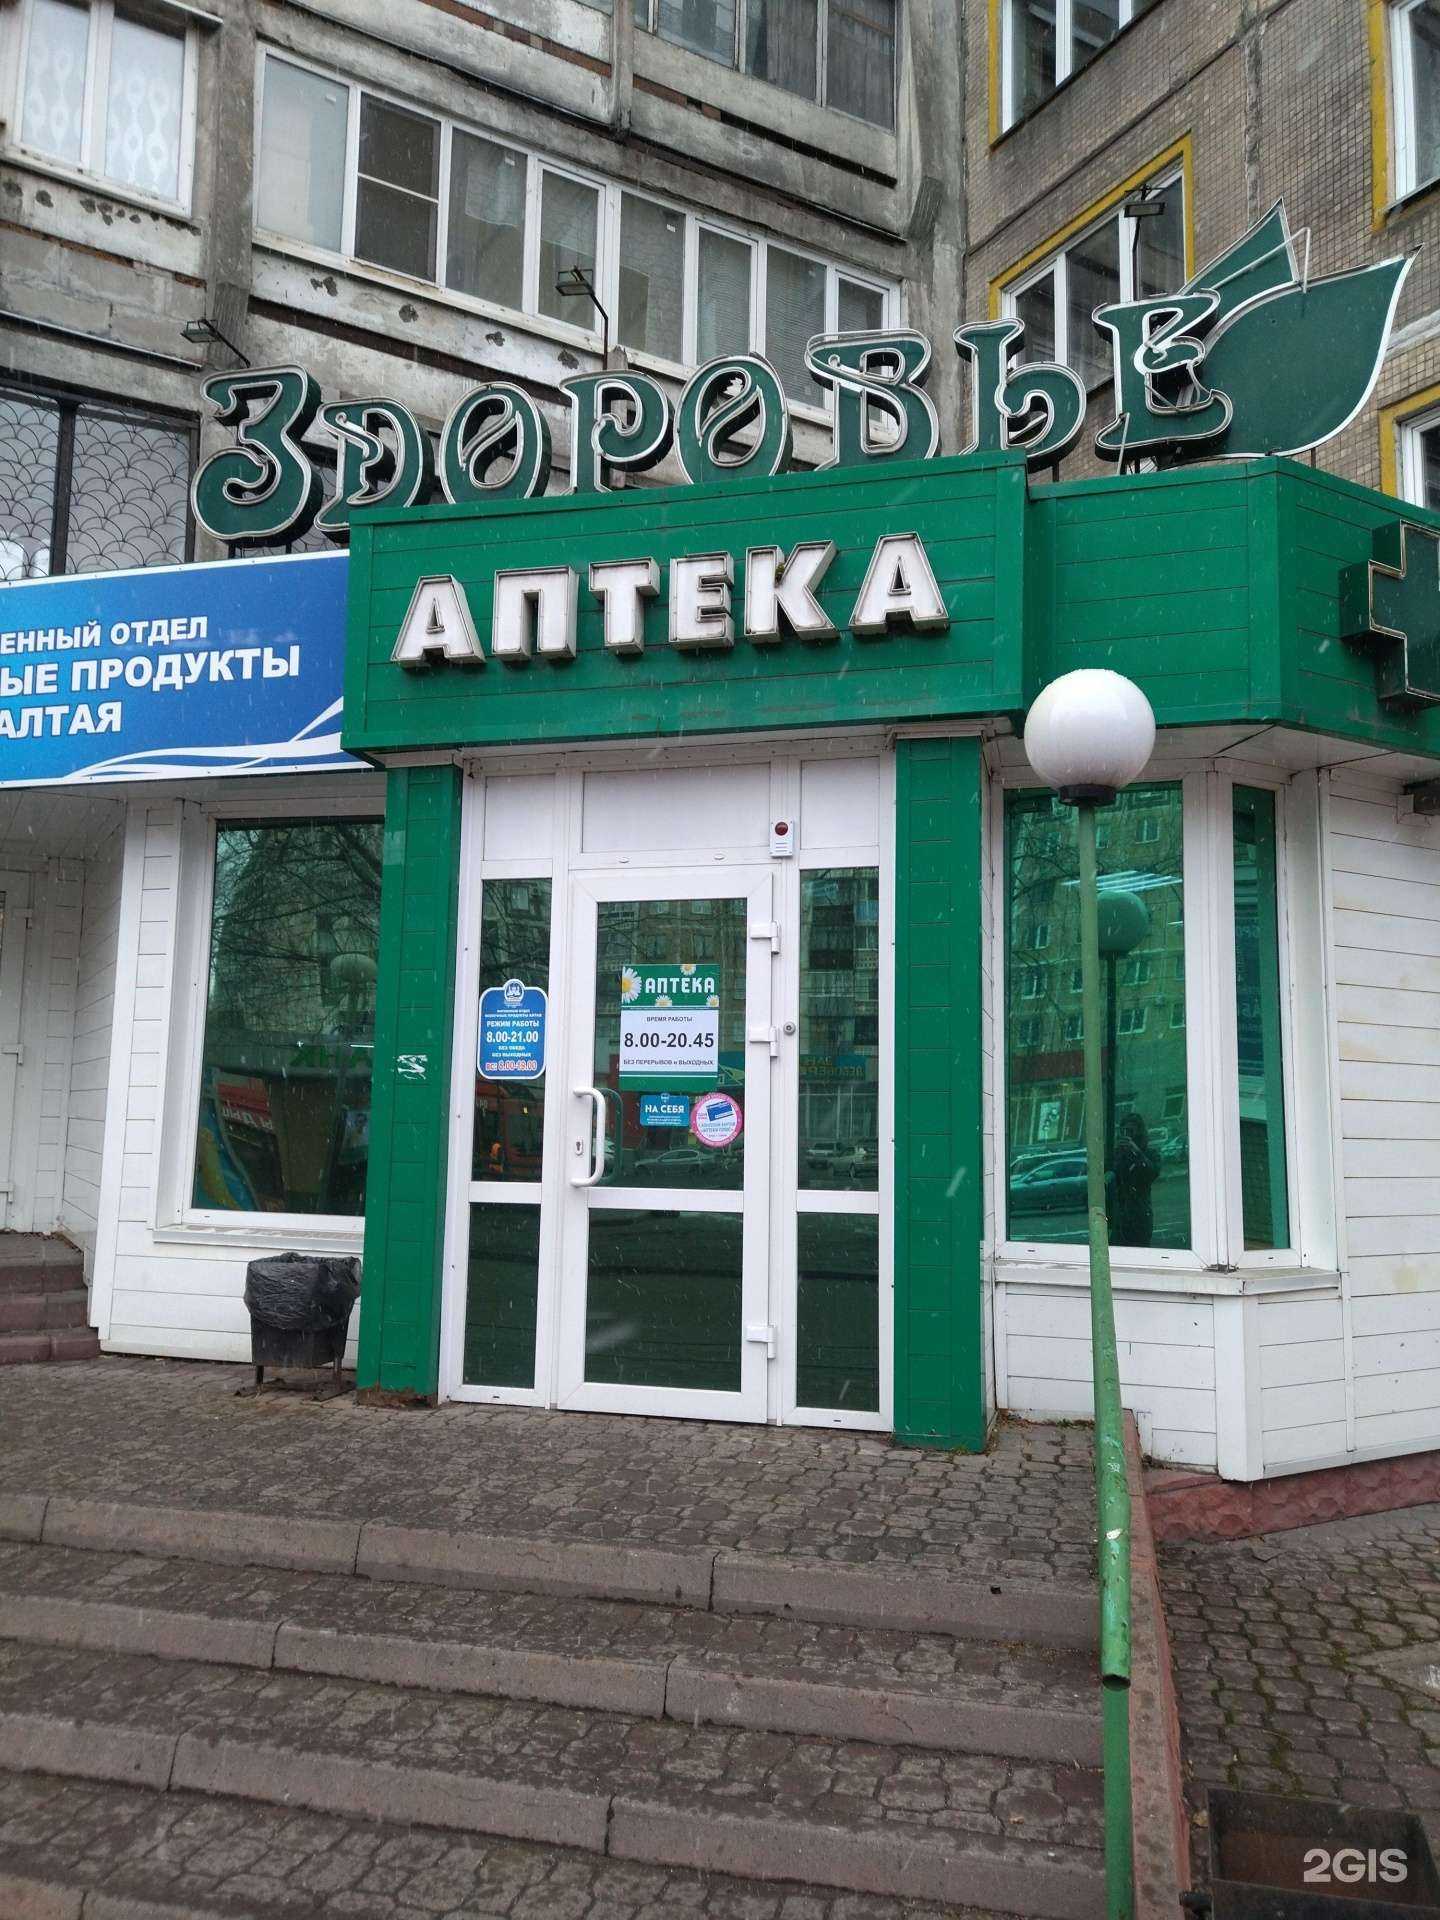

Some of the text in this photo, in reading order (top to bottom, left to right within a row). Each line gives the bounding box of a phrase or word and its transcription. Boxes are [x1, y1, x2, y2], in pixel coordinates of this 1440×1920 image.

[391, 531, 950, 669] АПТЕКА
[110, 616, 208, 646] ОТДЕЛ
[71, 645, 300, 691] ПРОДУКТЫ
[0, 701, 122, 739] АЛТАЯ
[645, 978, 715, 993] АПТЕКА
[486, 1031, 538, 1042] 8.00-21.00
[624, 1032, 714, 1047] 8.00-20.45
[645, 1105, 684, 1113] НА СЕБЯ
